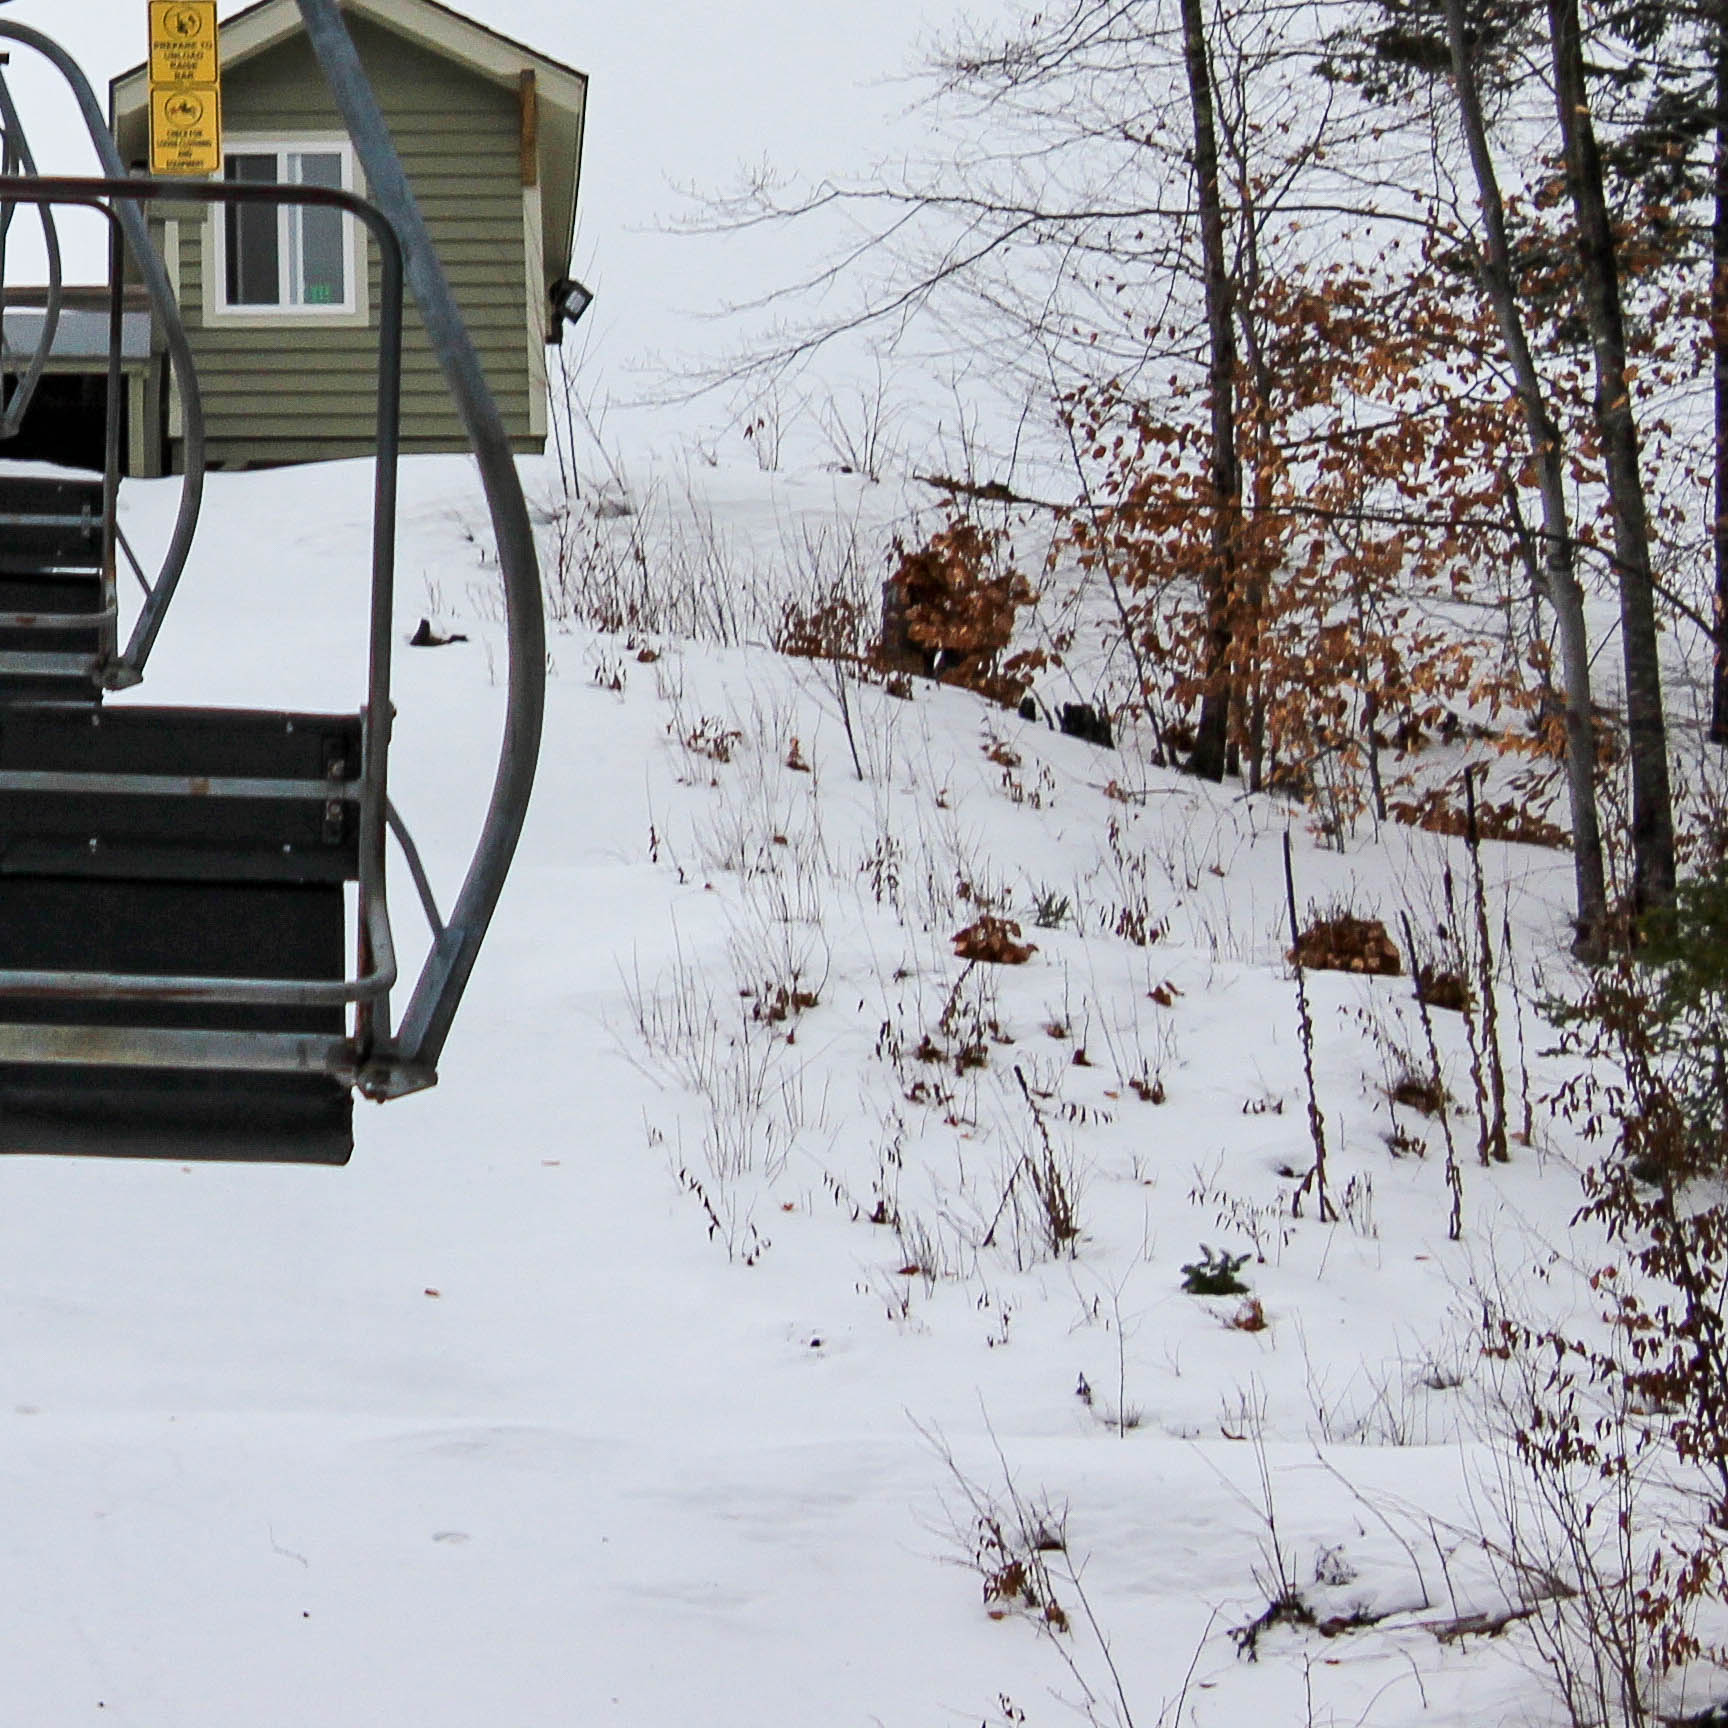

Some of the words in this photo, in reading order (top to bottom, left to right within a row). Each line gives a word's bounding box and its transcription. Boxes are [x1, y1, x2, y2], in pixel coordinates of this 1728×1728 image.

[153, 41, 197, 50] PREPARE
[200, 41, 213, 50] TO
[163, 52, 204, 61] UNLOAD
[174, 71, 194, 80] BAR
